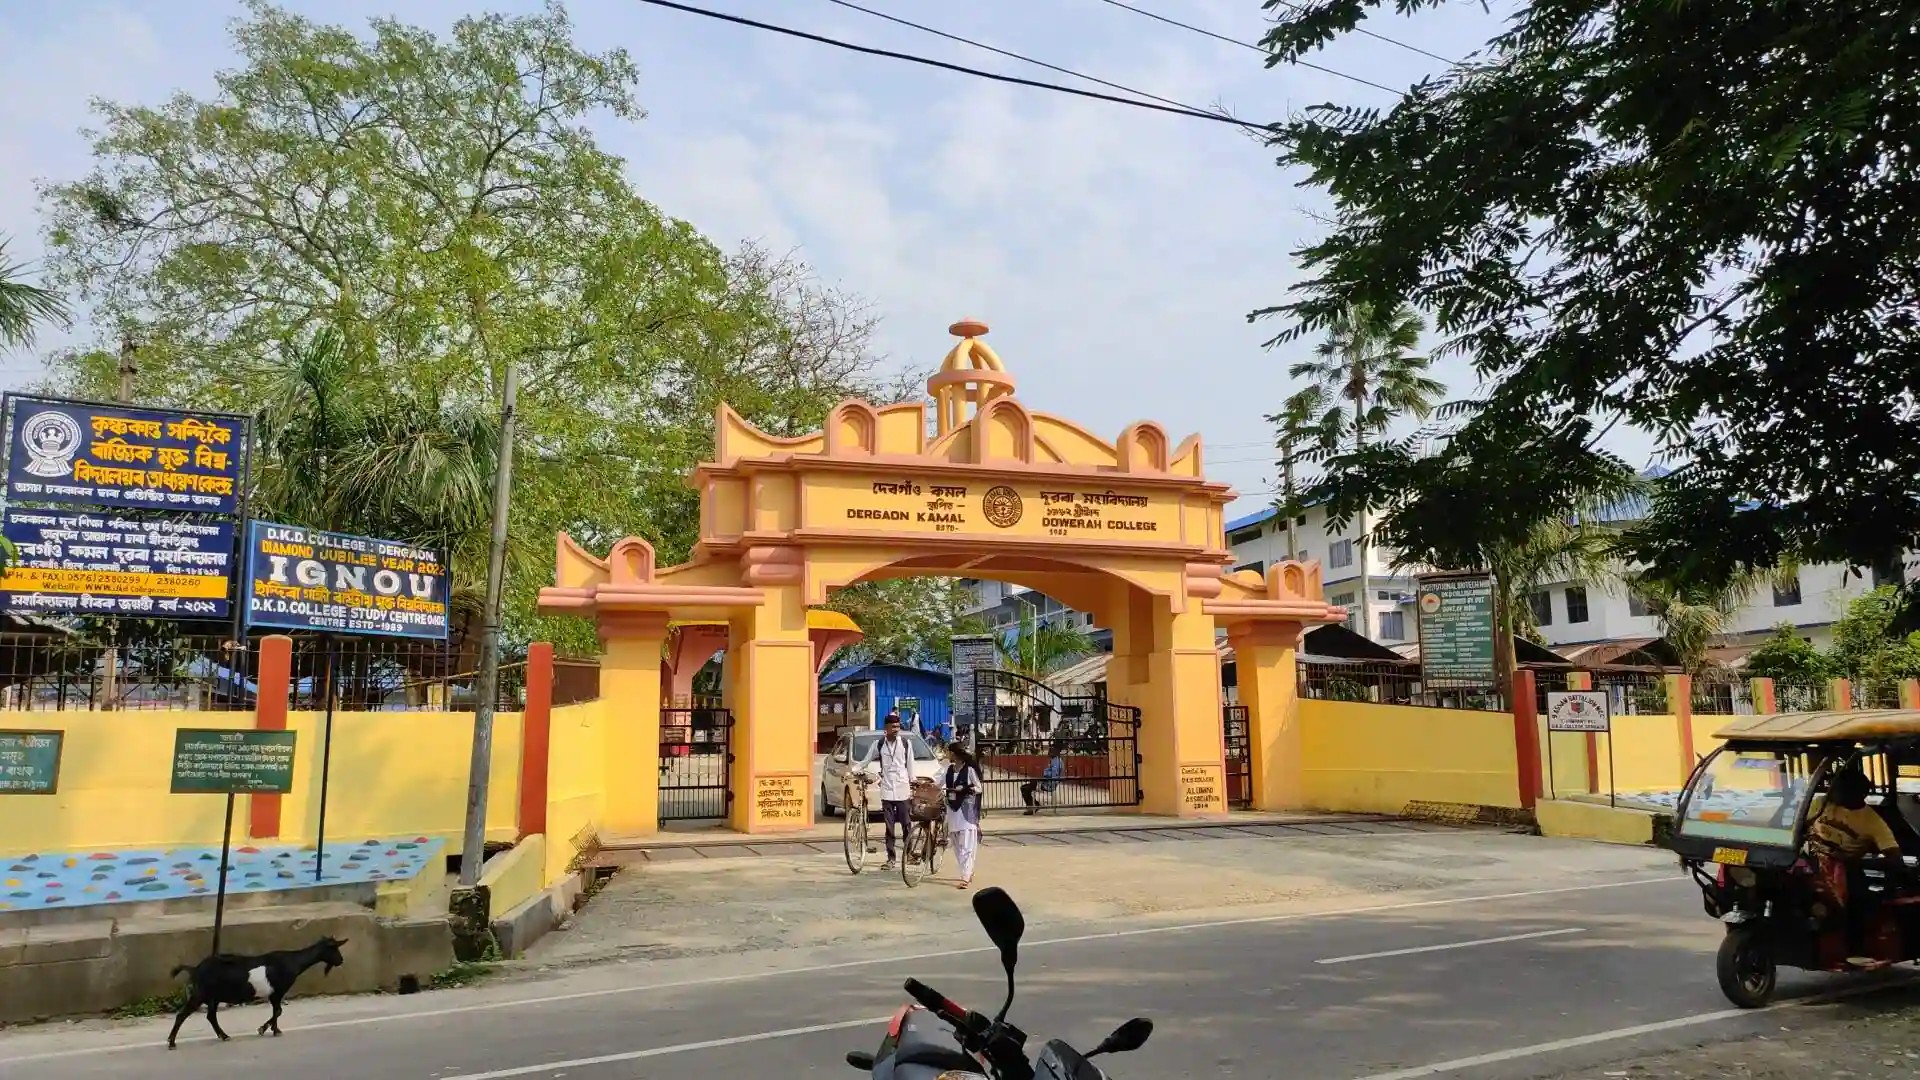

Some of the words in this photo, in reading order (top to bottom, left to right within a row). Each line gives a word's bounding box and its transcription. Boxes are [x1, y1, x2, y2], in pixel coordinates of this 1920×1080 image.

[157, 447, 189, 471] মুক্ত
[930, 485, 967, 498] কমল
[847, 508, 910, 520] DERGAON
[917, 512, 965, 523] KAMAL
[1042, 517, 1102, 529] DOWERAH
[1107, 520, 1157, 531] COLLEGE
[308, 533, 366, 551] COLLEGE
[68, 545, 109, 560] কমল
[262, 540, 314, 558] DIAMOND
[320, 549, 377, 567] JUBILEE
[382, 556, 414, 572] YEAR
[417, 561, 445, 576] 2022
[351, 607, 387, 620] STUDY
[308, 617, 346, 628] CENTRE
